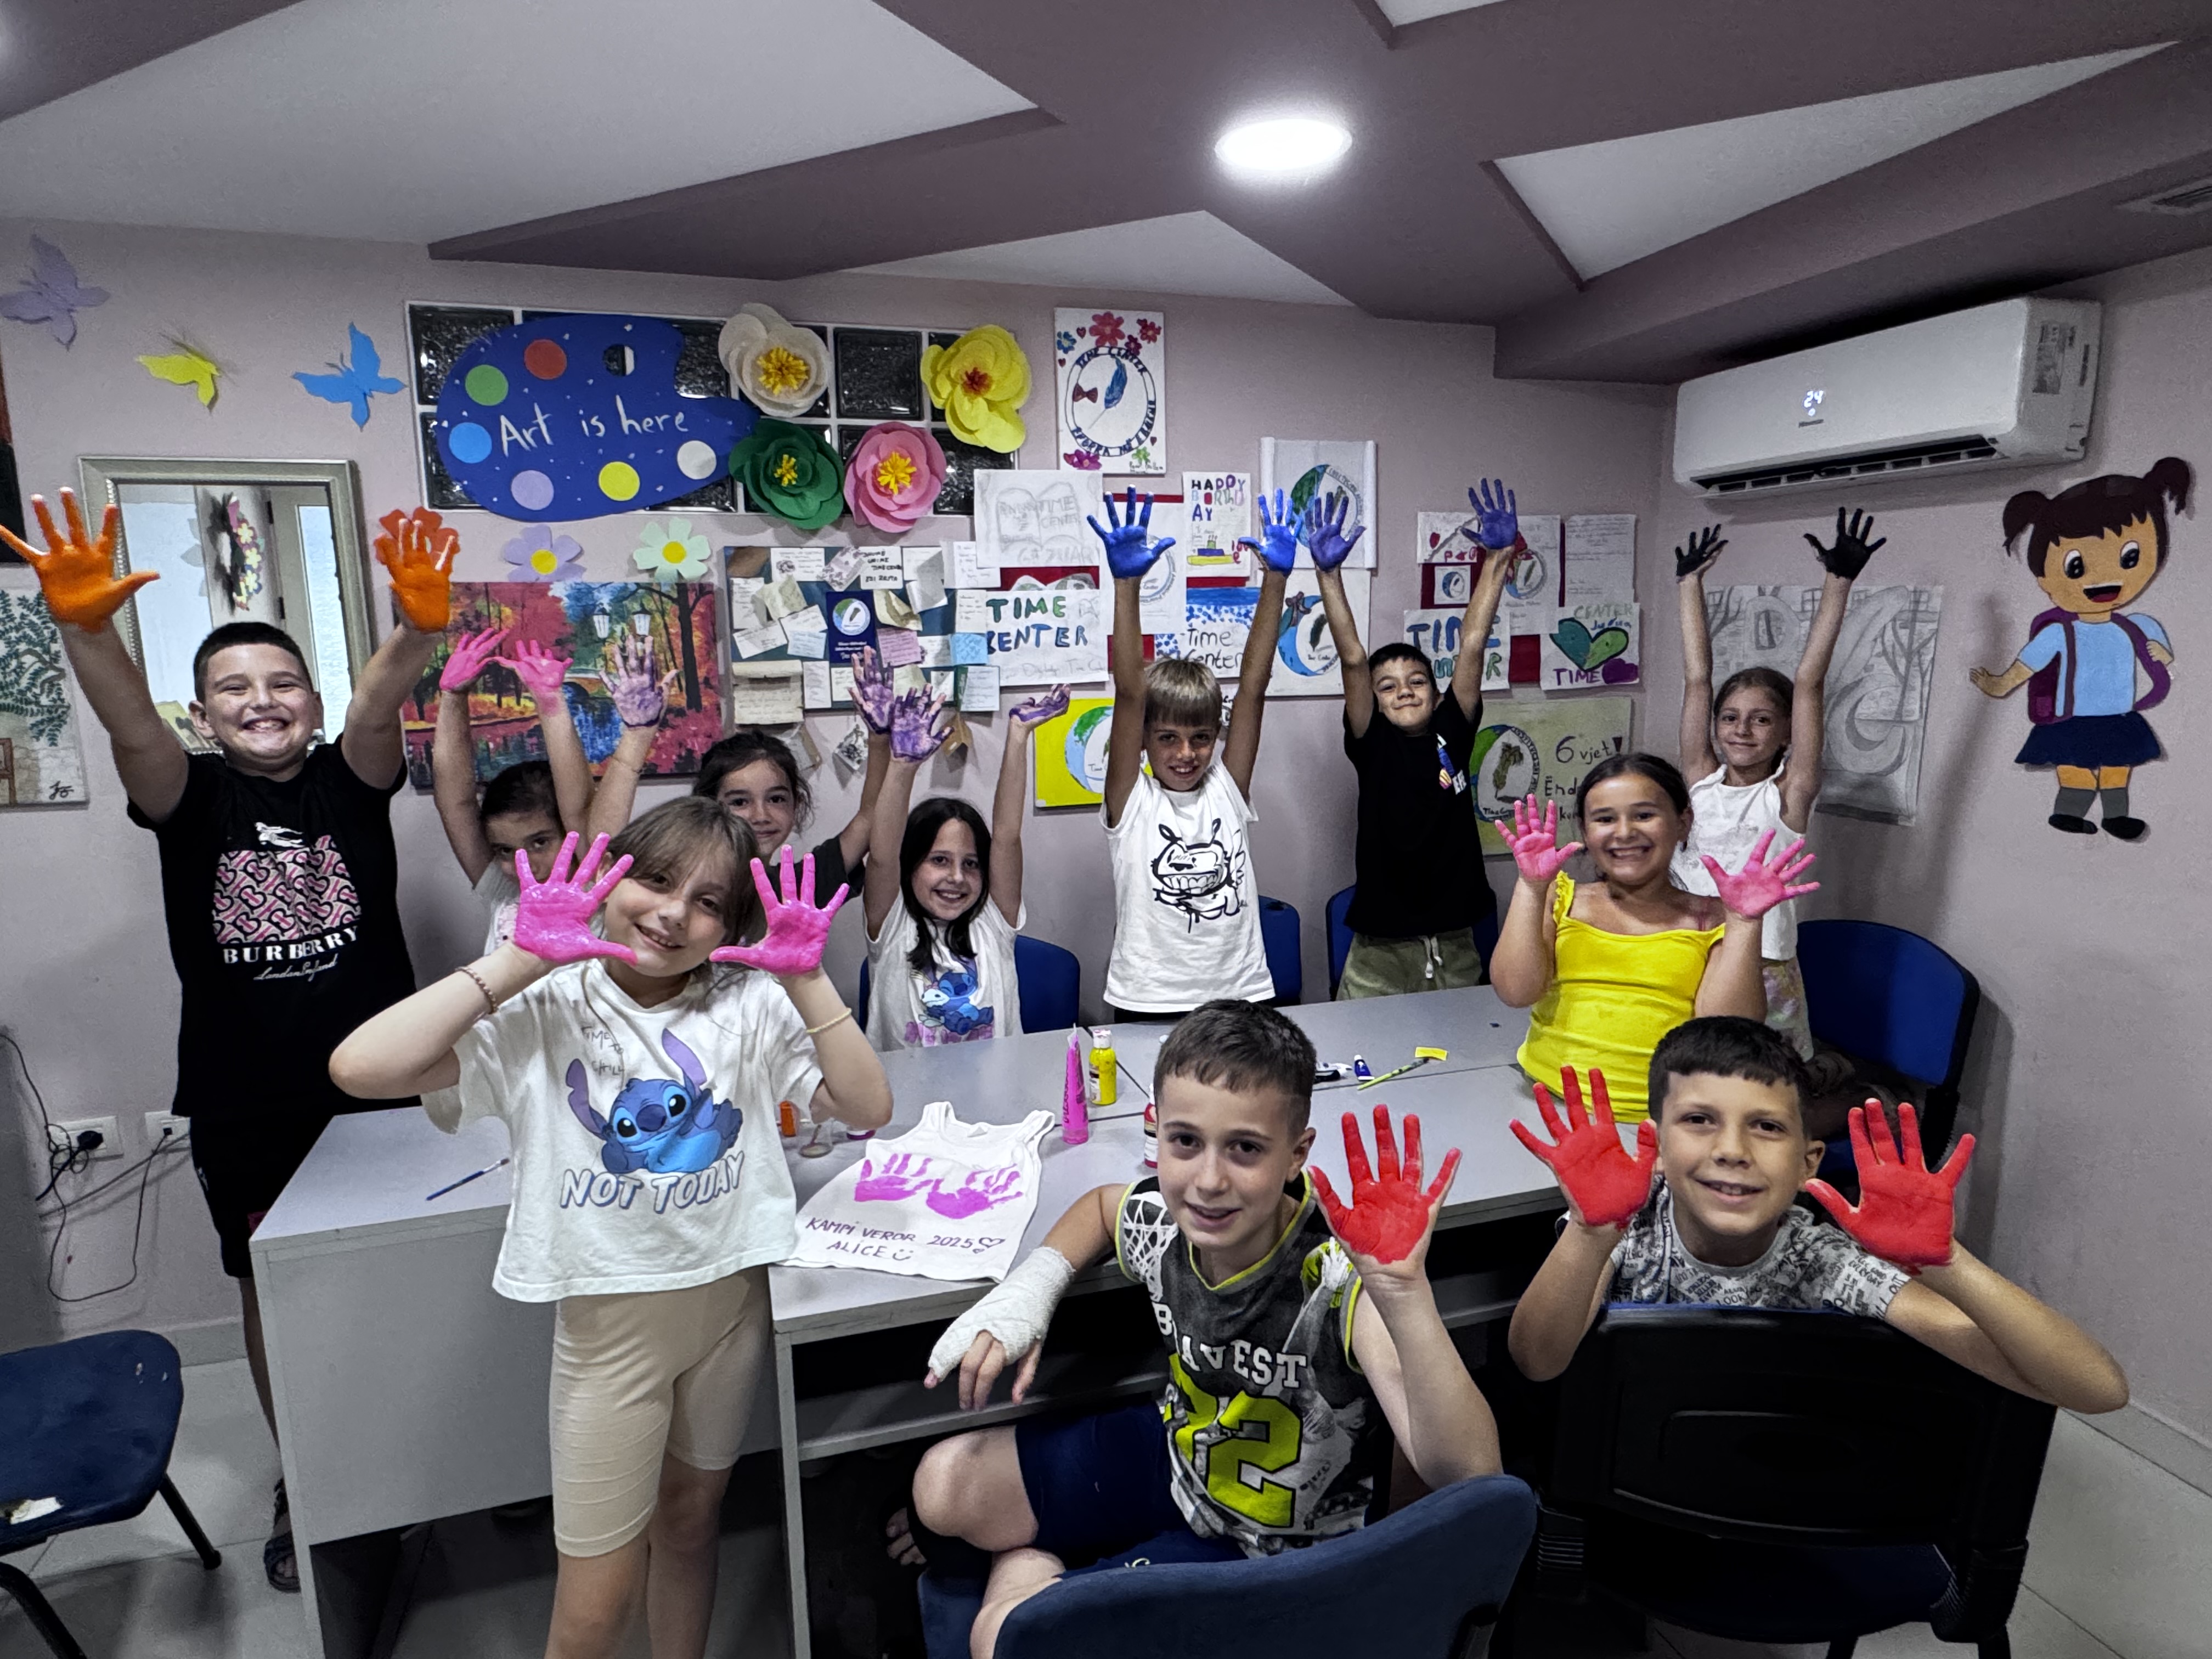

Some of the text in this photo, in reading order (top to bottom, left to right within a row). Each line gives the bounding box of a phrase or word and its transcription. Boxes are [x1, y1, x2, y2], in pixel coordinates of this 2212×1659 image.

[1804, 390, 1824, 408] 24
[500, 394, 689, 456] Art is here
[1192, 504, 1212, 521] AY
[986, 596, 1066, 623] TIME
[1553, 668, 1601, 686] TIME
[1555, 736, 1576, 764] 6
[223, 926, 357, 964] BURBERRY
[560, 1150, 745, 1215] NOT TODAY
[927, 1235, 973, 1249] 2025
[1152, 1301, 1307, 1389] BAVEST
